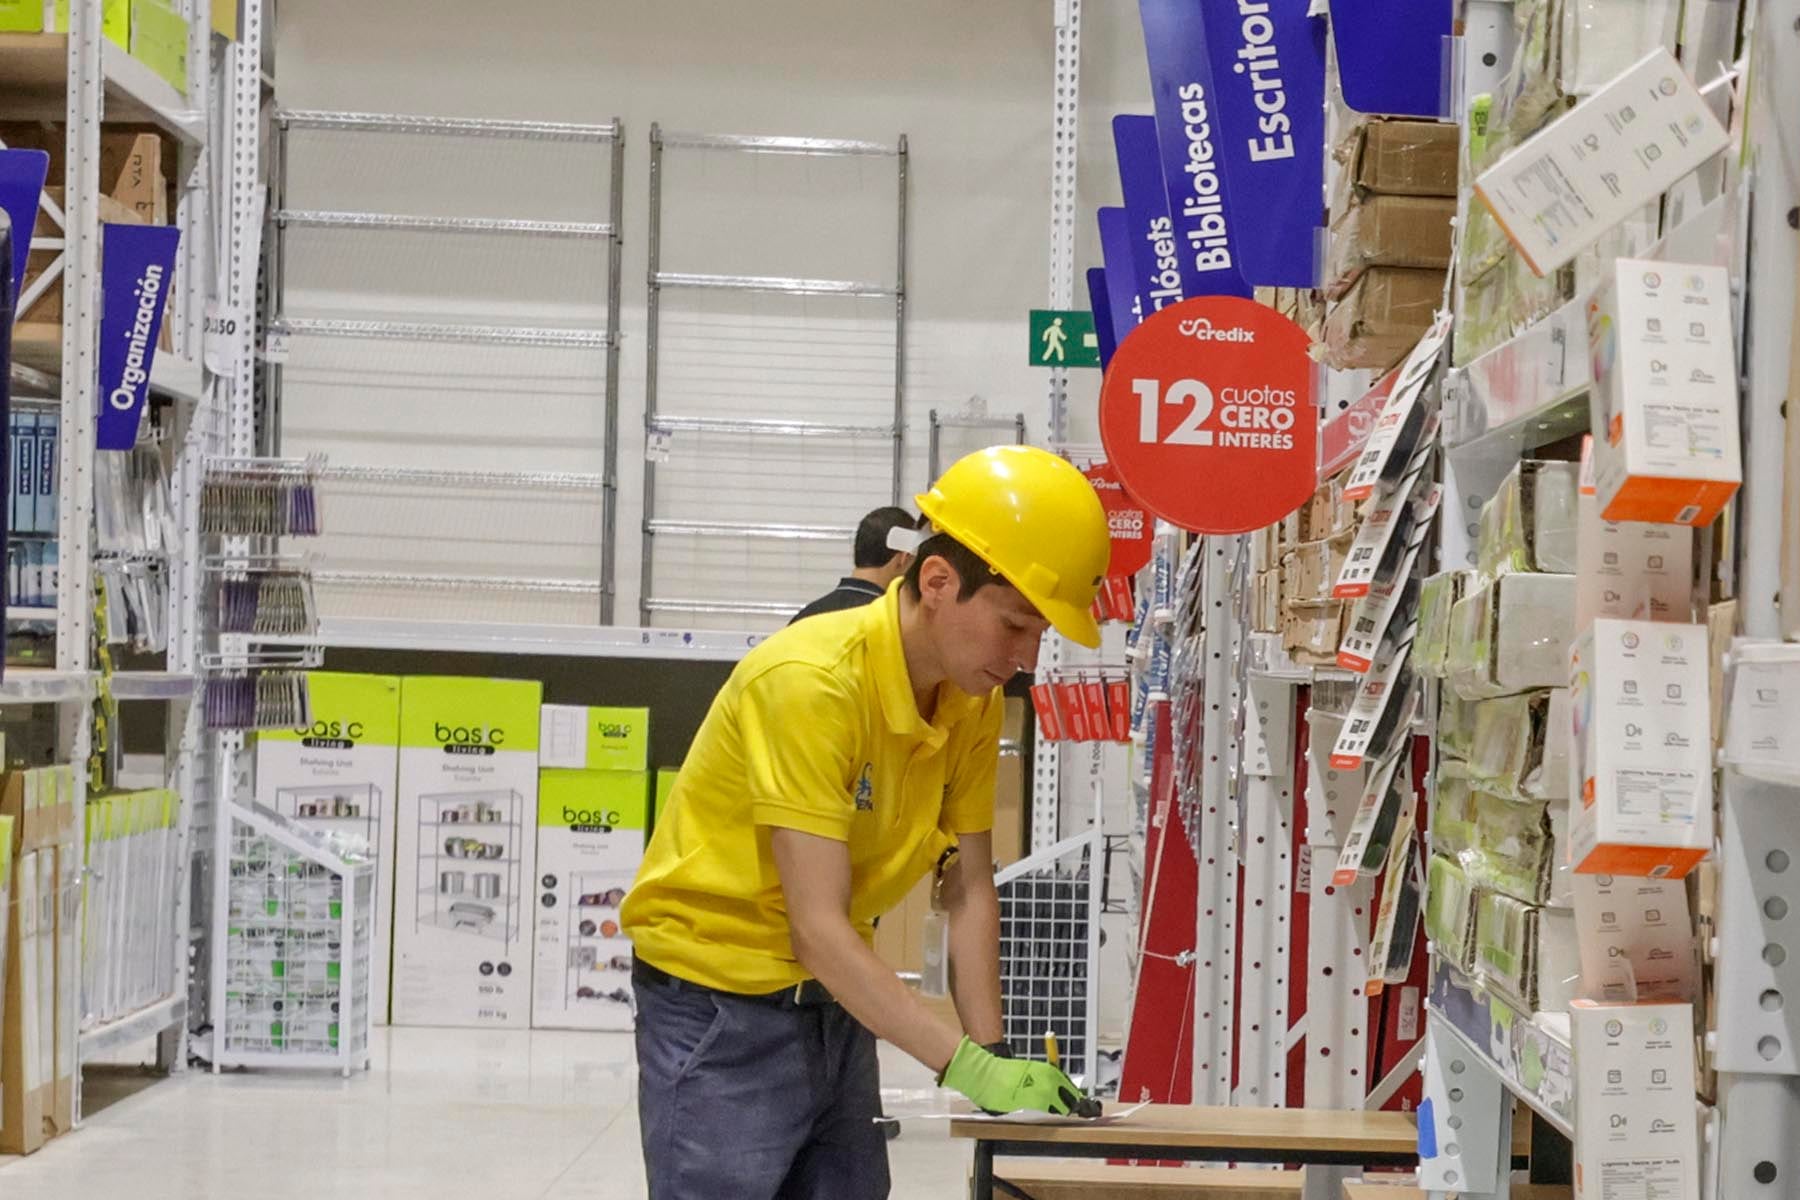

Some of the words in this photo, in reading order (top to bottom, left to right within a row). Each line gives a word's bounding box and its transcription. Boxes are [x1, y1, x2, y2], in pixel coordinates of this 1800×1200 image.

[1179, 82, 1231, 272] Bibliotecas
[110, 264, 163, 410] Organización
[1220, 385, 1295, 406] cuotas
[1131, 378, 1214, 447] 12
[1219, 406, 1295, 430] CERO
[1218, 430, 1294, 449] INTERÉS
[1108, 519, 1144, 530] CERO
[435, 721, 504, 745] basic
[563, 805, 620, 825] basic
